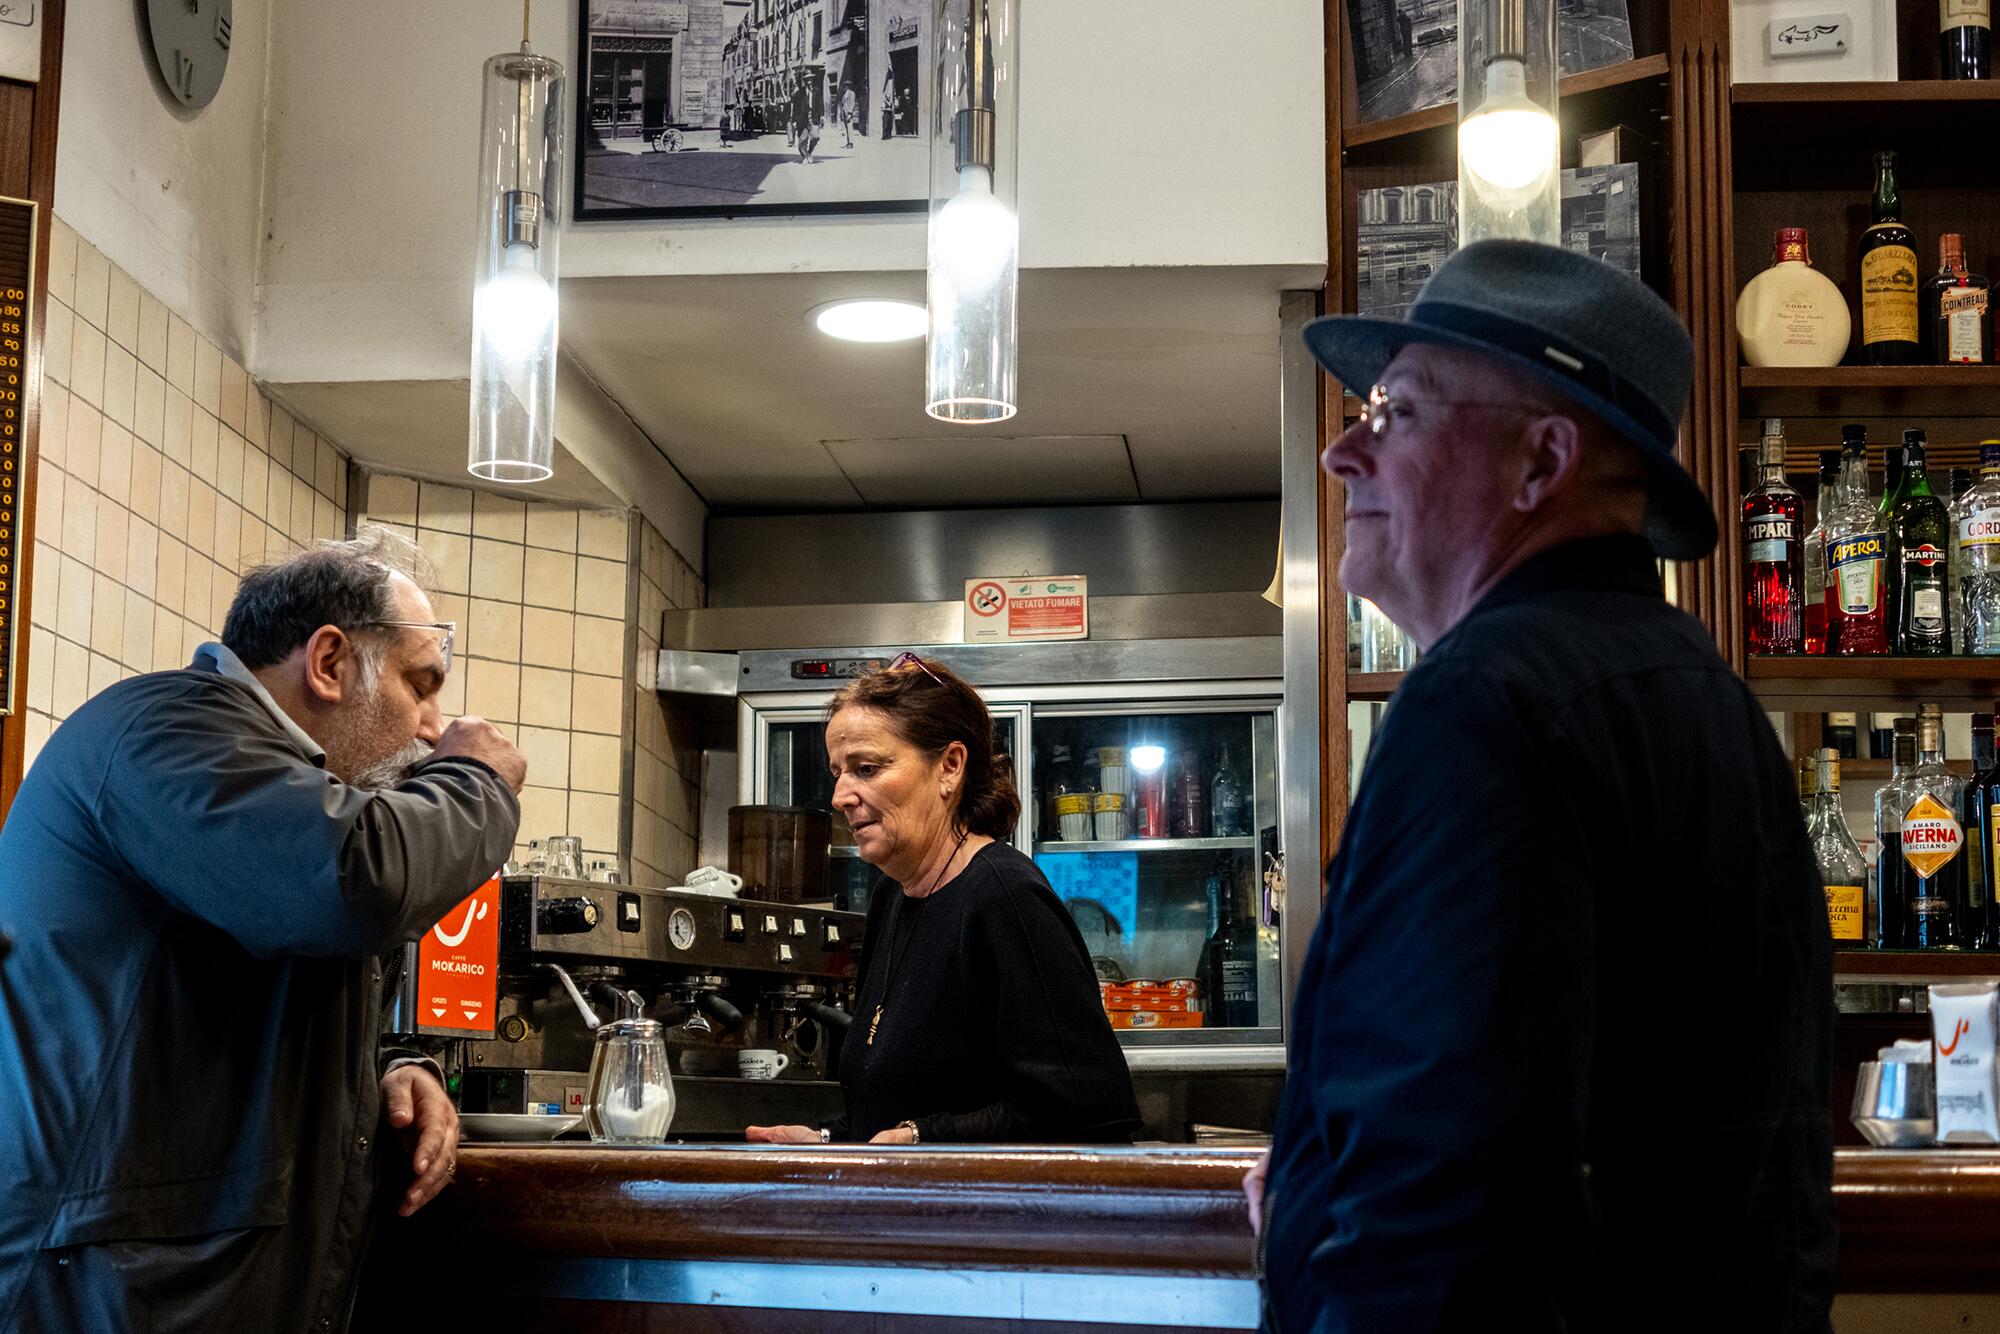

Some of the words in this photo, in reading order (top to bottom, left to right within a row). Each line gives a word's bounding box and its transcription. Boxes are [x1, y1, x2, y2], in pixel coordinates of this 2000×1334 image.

[1943, 293, 1985, 312] COINTREAU
[1832, 539, 1882, 564] APEROL
[1906, 551, 1945, 560] MARTINI
[1010, 599, 1044, 609] VIETATO
[1046, 597, 1081, 608] FUMARE
[1903, 828, 1957, 844] AVERNA
[1829, 905, 1859, 913] ECCHIO
[1830, 913, 1848, 921] NCA
[431, 959, 485, 976] MOKARICO
